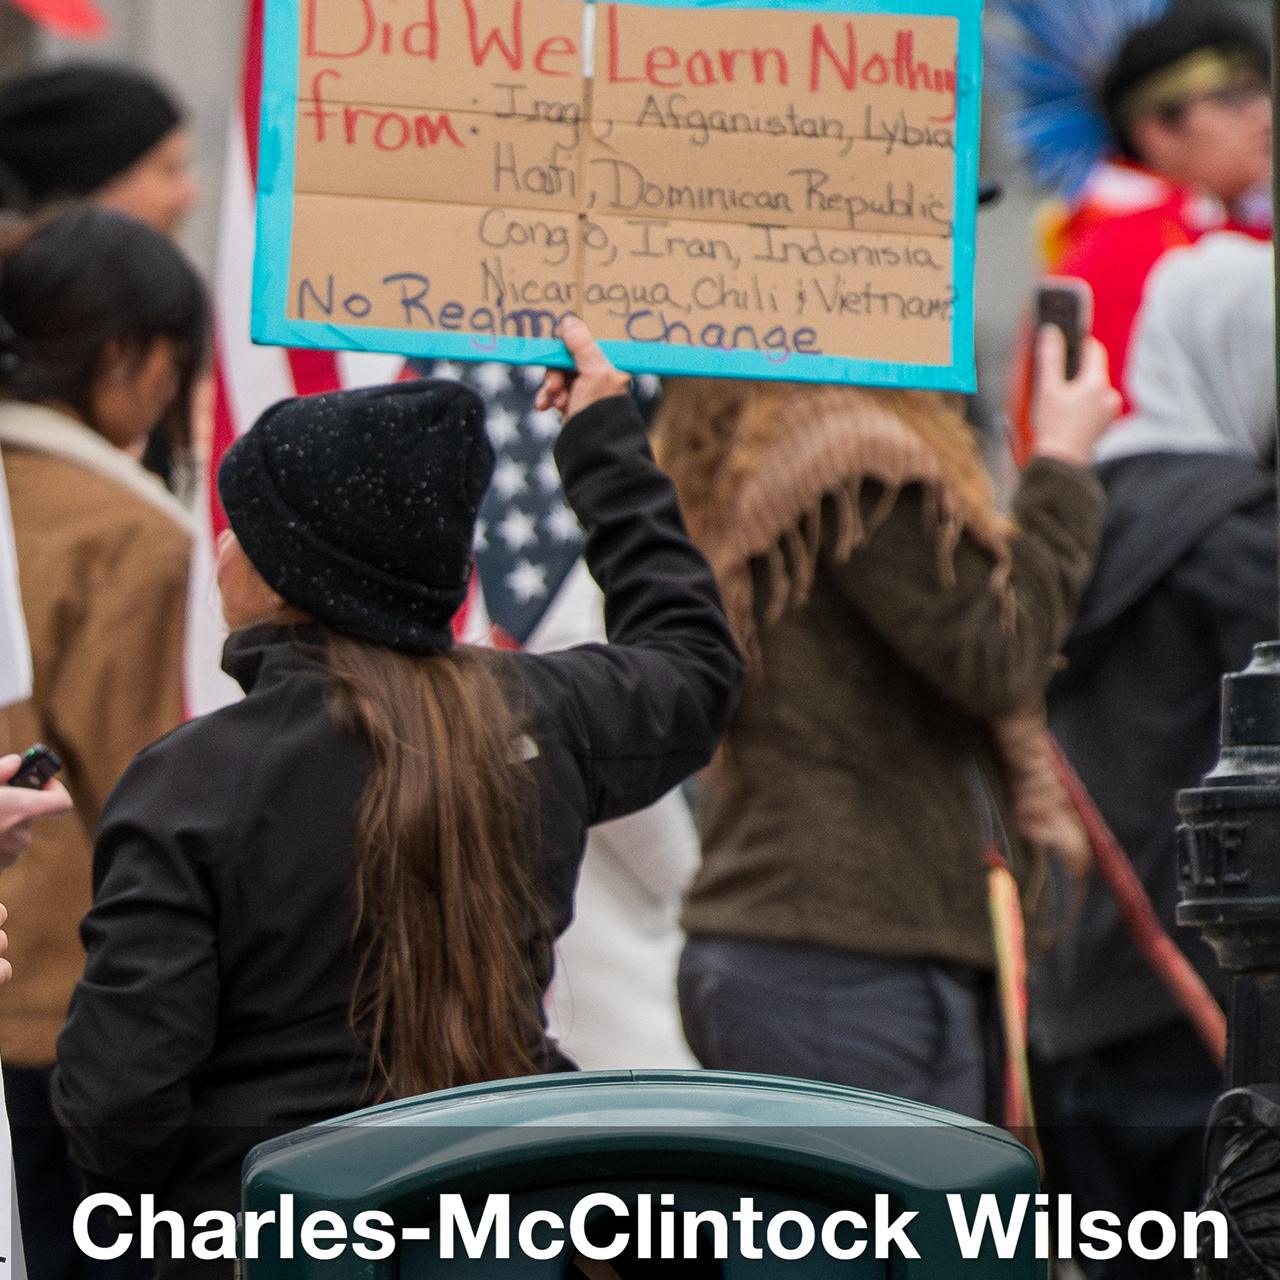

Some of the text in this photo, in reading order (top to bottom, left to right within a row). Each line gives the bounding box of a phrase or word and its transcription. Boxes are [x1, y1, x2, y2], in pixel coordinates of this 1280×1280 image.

[303, 0, 438, 61] Did
[462, 0, 579, 78] We
[607, 3, 789, 88] Learn
[296, 270, 373, 321] No
[625, 308, 823, 364] Change
